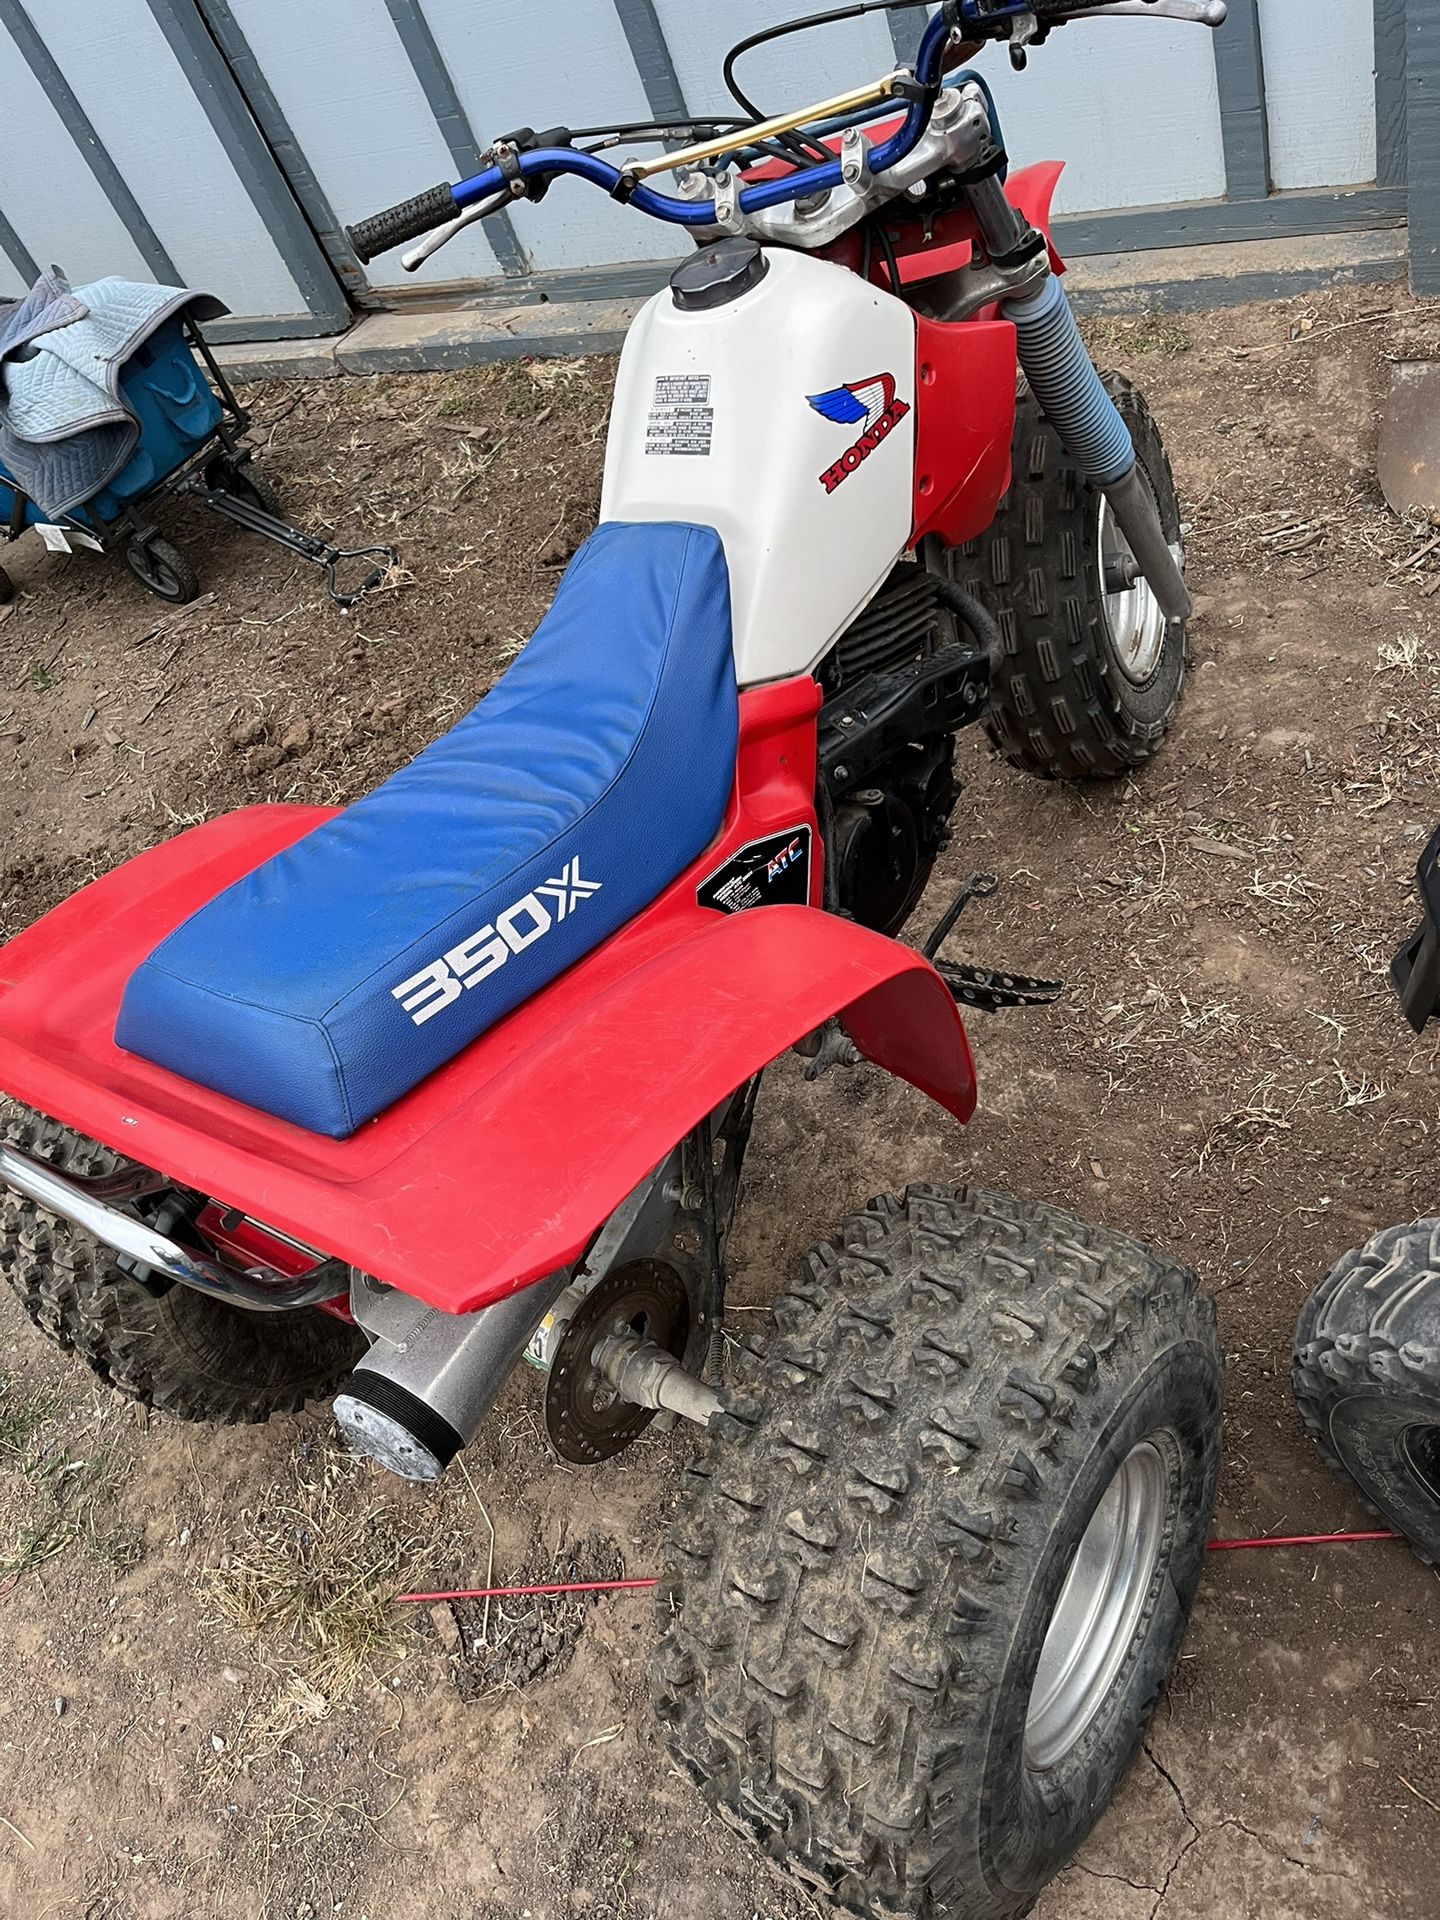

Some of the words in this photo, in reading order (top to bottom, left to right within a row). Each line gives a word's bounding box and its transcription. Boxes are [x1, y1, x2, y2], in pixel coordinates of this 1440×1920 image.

[819, 398, 911, 495] HONDA
[767, 836, 803, 883] ATC
[391, 855, 603, 1026] 350X
